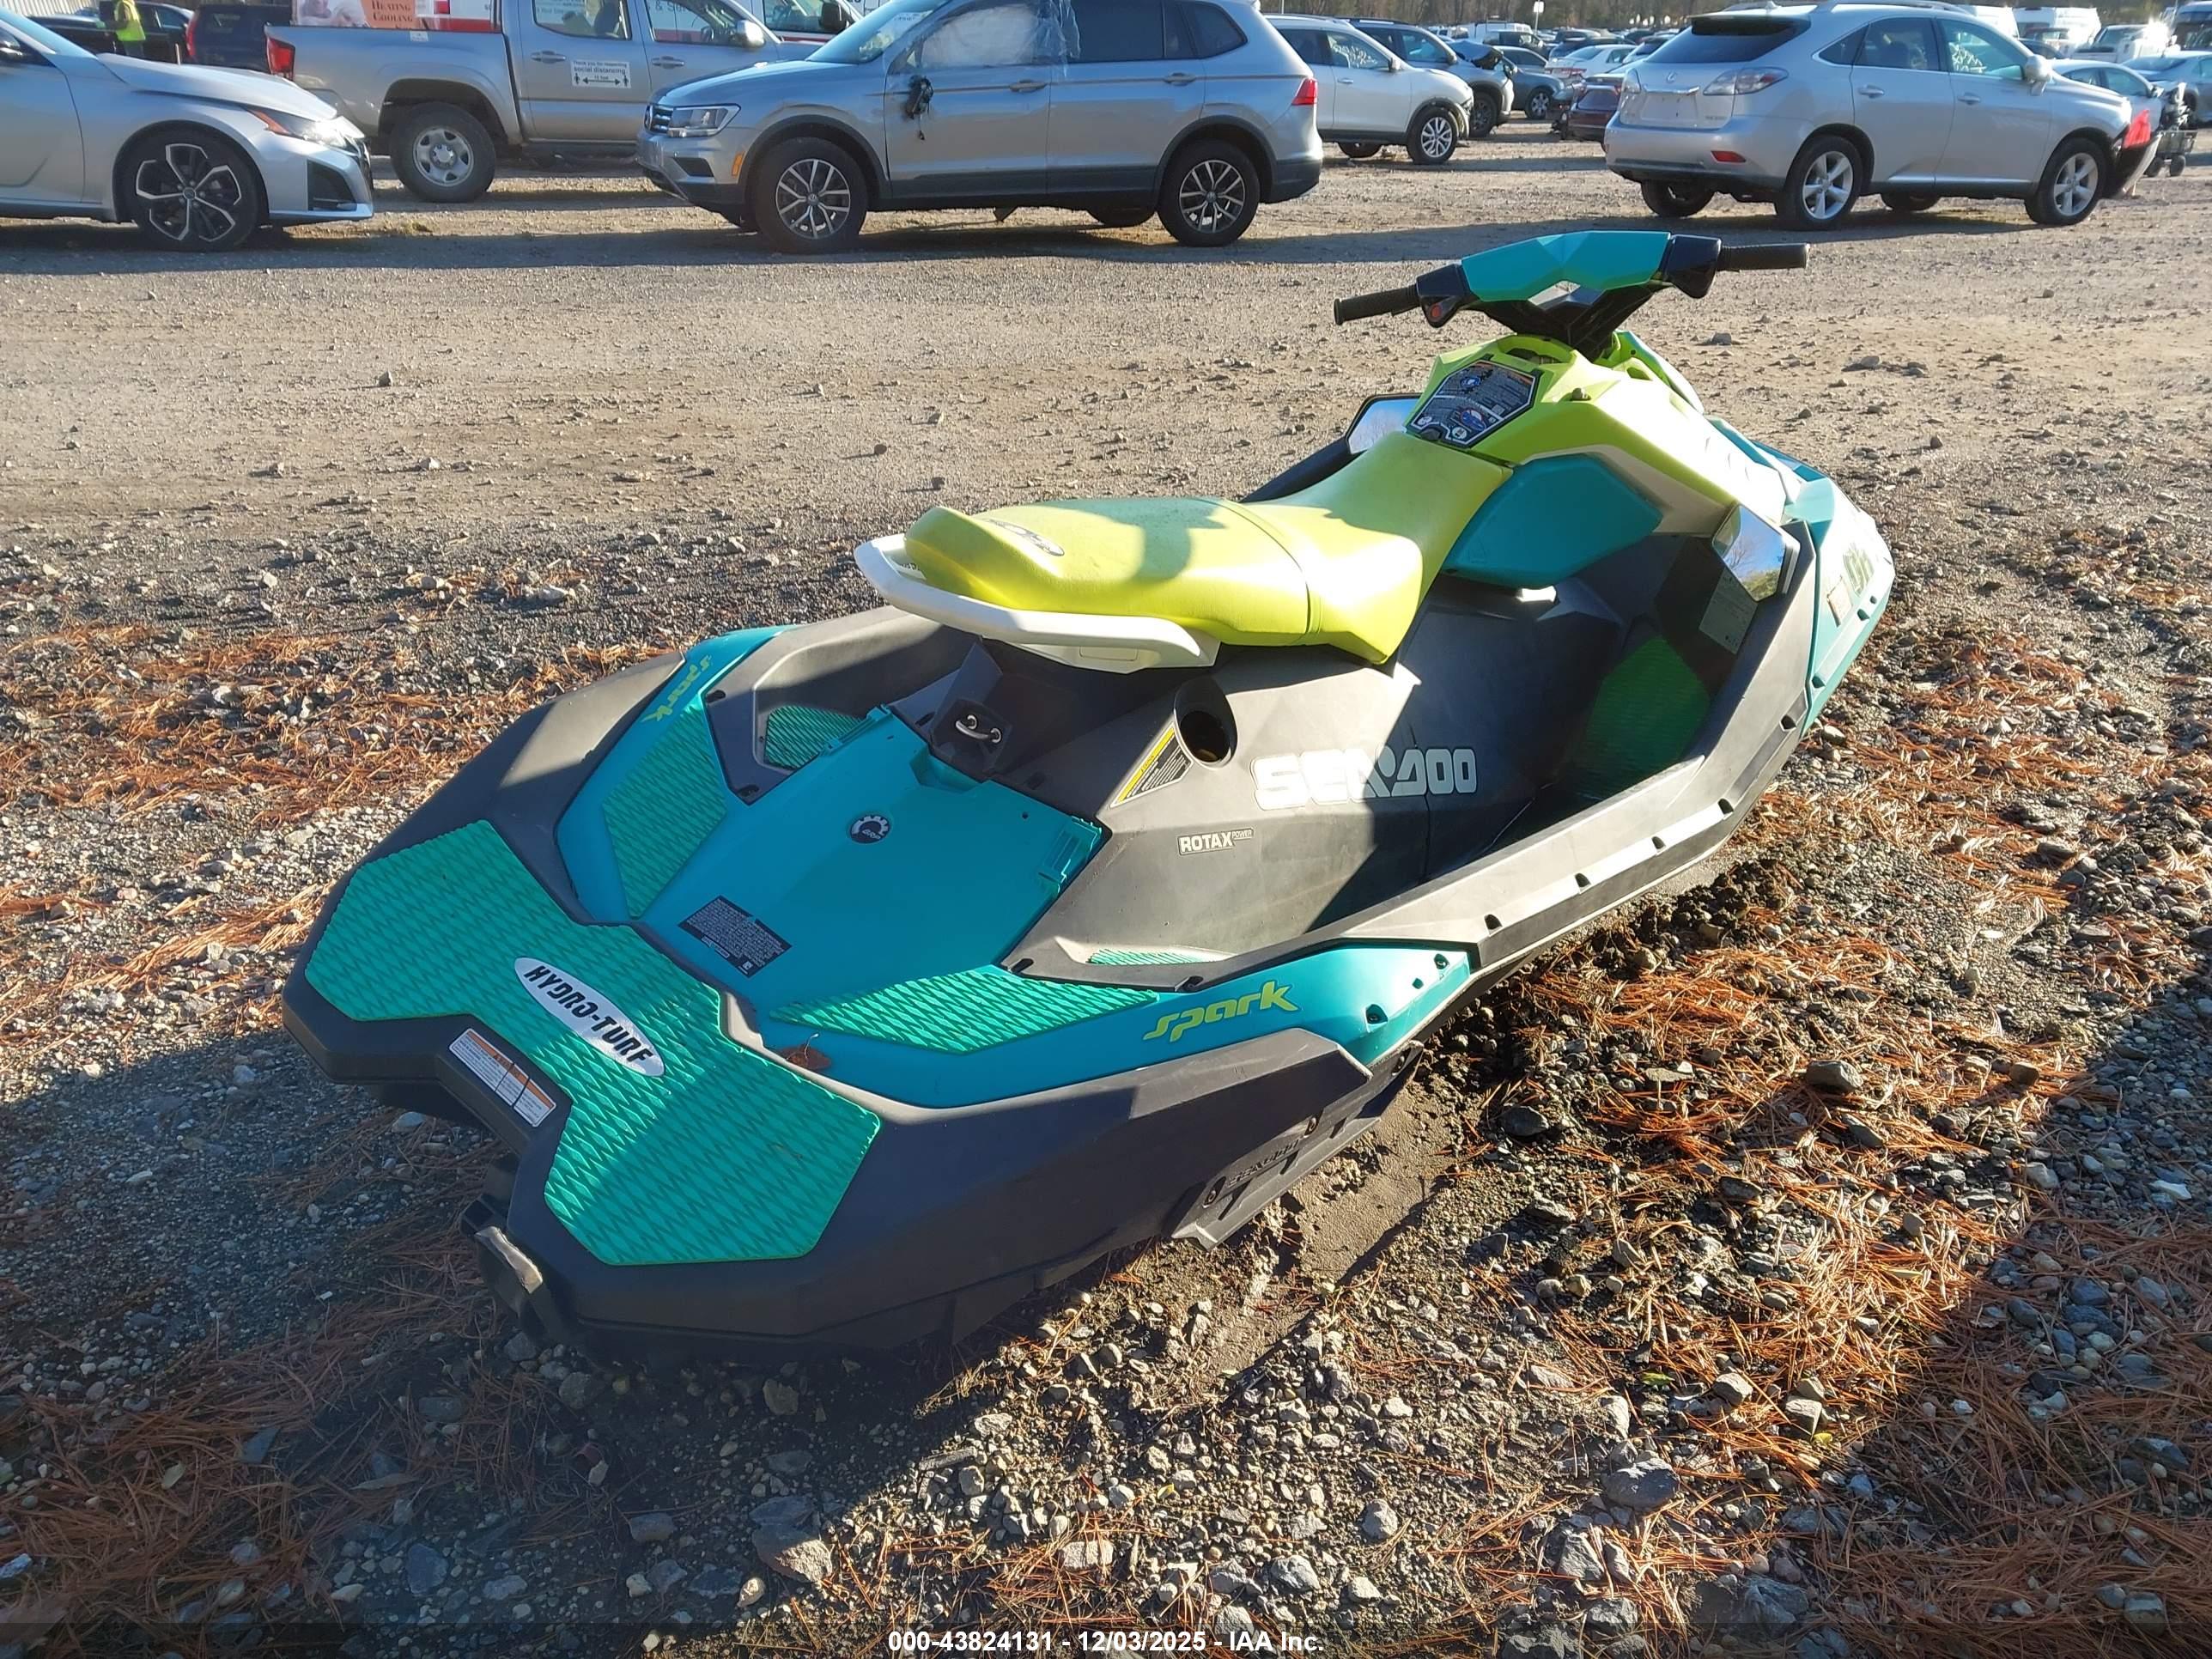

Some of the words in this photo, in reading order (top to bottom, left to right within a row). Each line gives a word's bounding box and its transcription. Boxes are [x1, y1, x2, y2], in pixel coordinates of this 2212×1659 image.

[372, 0, 411, 11] HEATING
[373, 12, 413, 22] COOLING
[593, 67, 626, 76] distancing
[1180, 831, 1233, 853] ROTAX
[1231, 830, 1252, 839] POWER
[523, 965, 653, 1062] HYDRO-TURF
[1143, 981, 1298, 1042] spark
